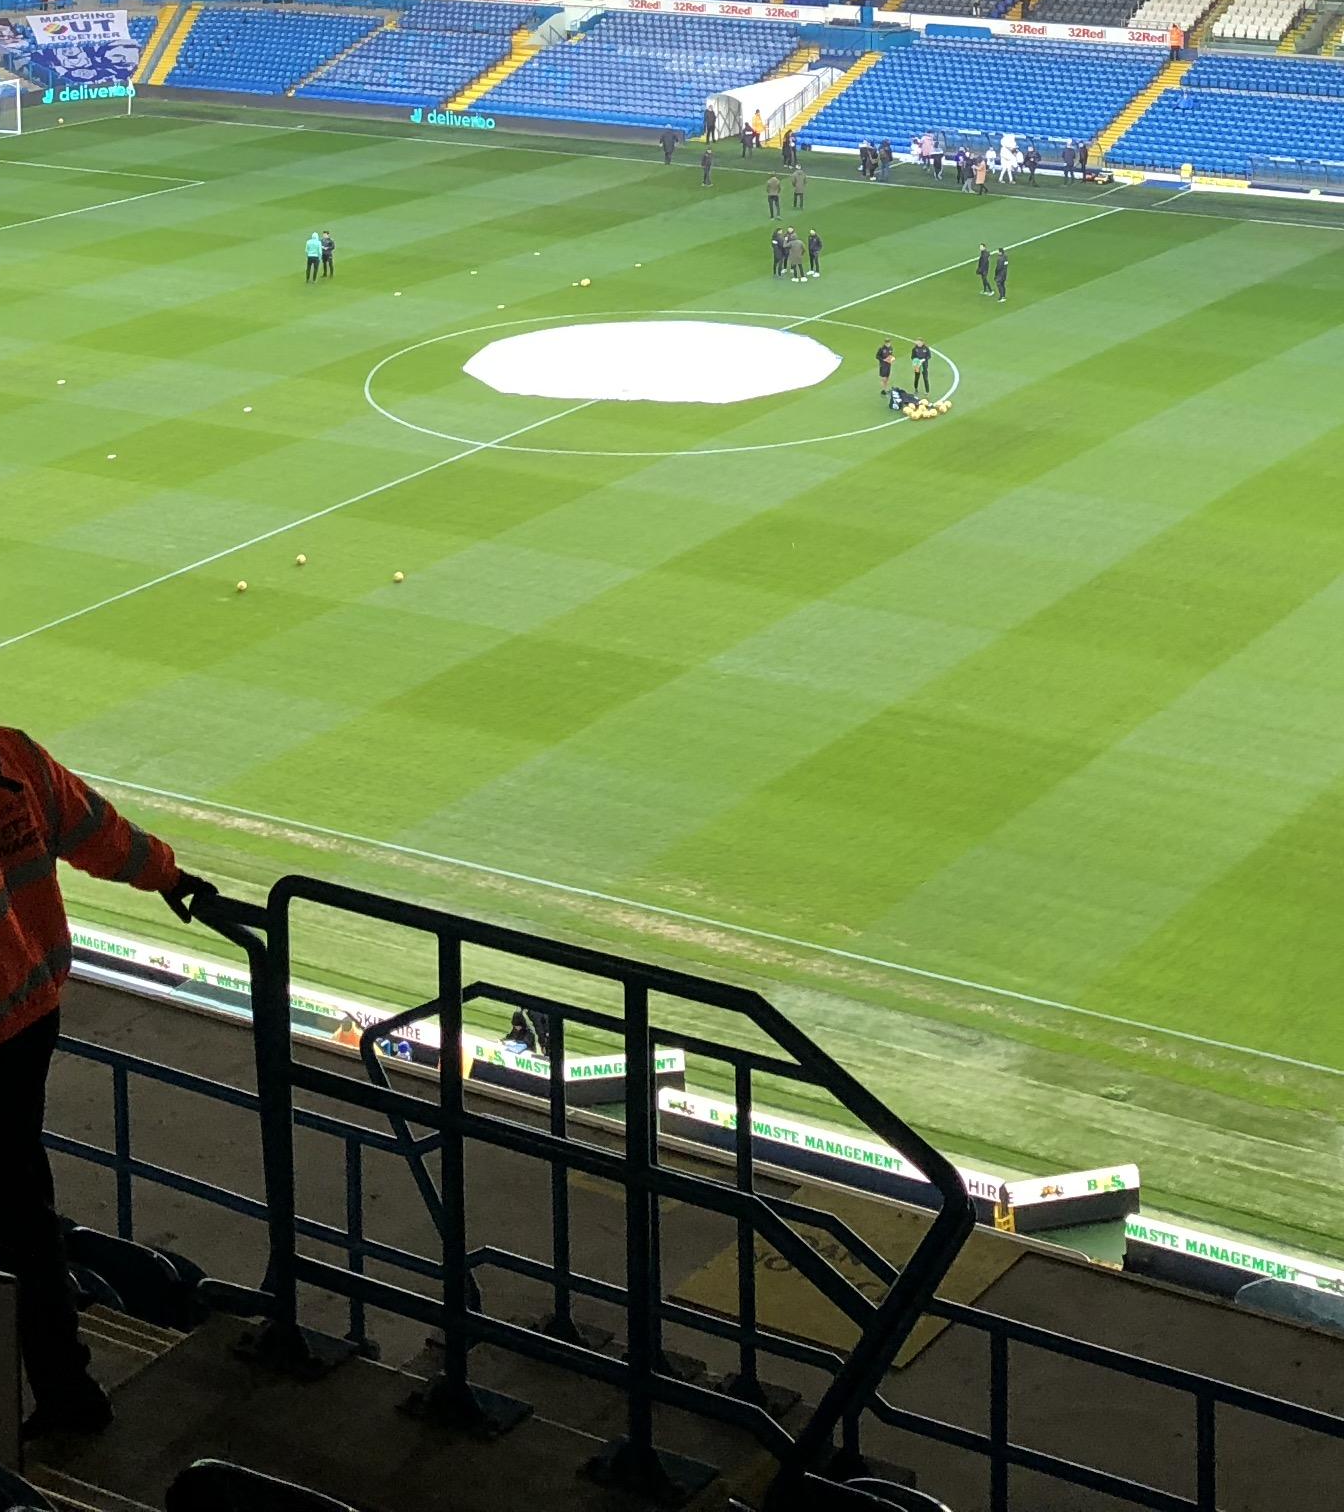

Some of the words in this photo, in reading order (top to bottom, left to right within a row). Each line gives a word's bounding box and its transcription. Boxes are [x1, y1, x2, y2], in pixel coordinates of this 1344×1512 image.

[628, 0, 659, 10] 32Red
[673, 2, 705, 13] 32Red
[718, 4, 752, 15] 32Red
[40, 12, 116, 23] MARCHING
[765, 7, 799, 18] 32Red
[1009, 23, 1045, 35] 32Red
[1068, 27, 1103, 39] 32Red
[49, 31, 120, 41] TOGETHER
[1127, 31, 1164, 43] 32Red
[72, 933, 137, 959] ANAGEMENT
[516, 1056, 550, 1075] WAST
[570, 1057, 677, 1078] MANAGNT
[753, 1120, 800, 1144] WASTE
[805, 1135, 903, 1171] MANAGEMENT
[1126, 1223, 1179, 1248] WASTE
[1185, 1239, 1299, 1282] MANAGEMENT
